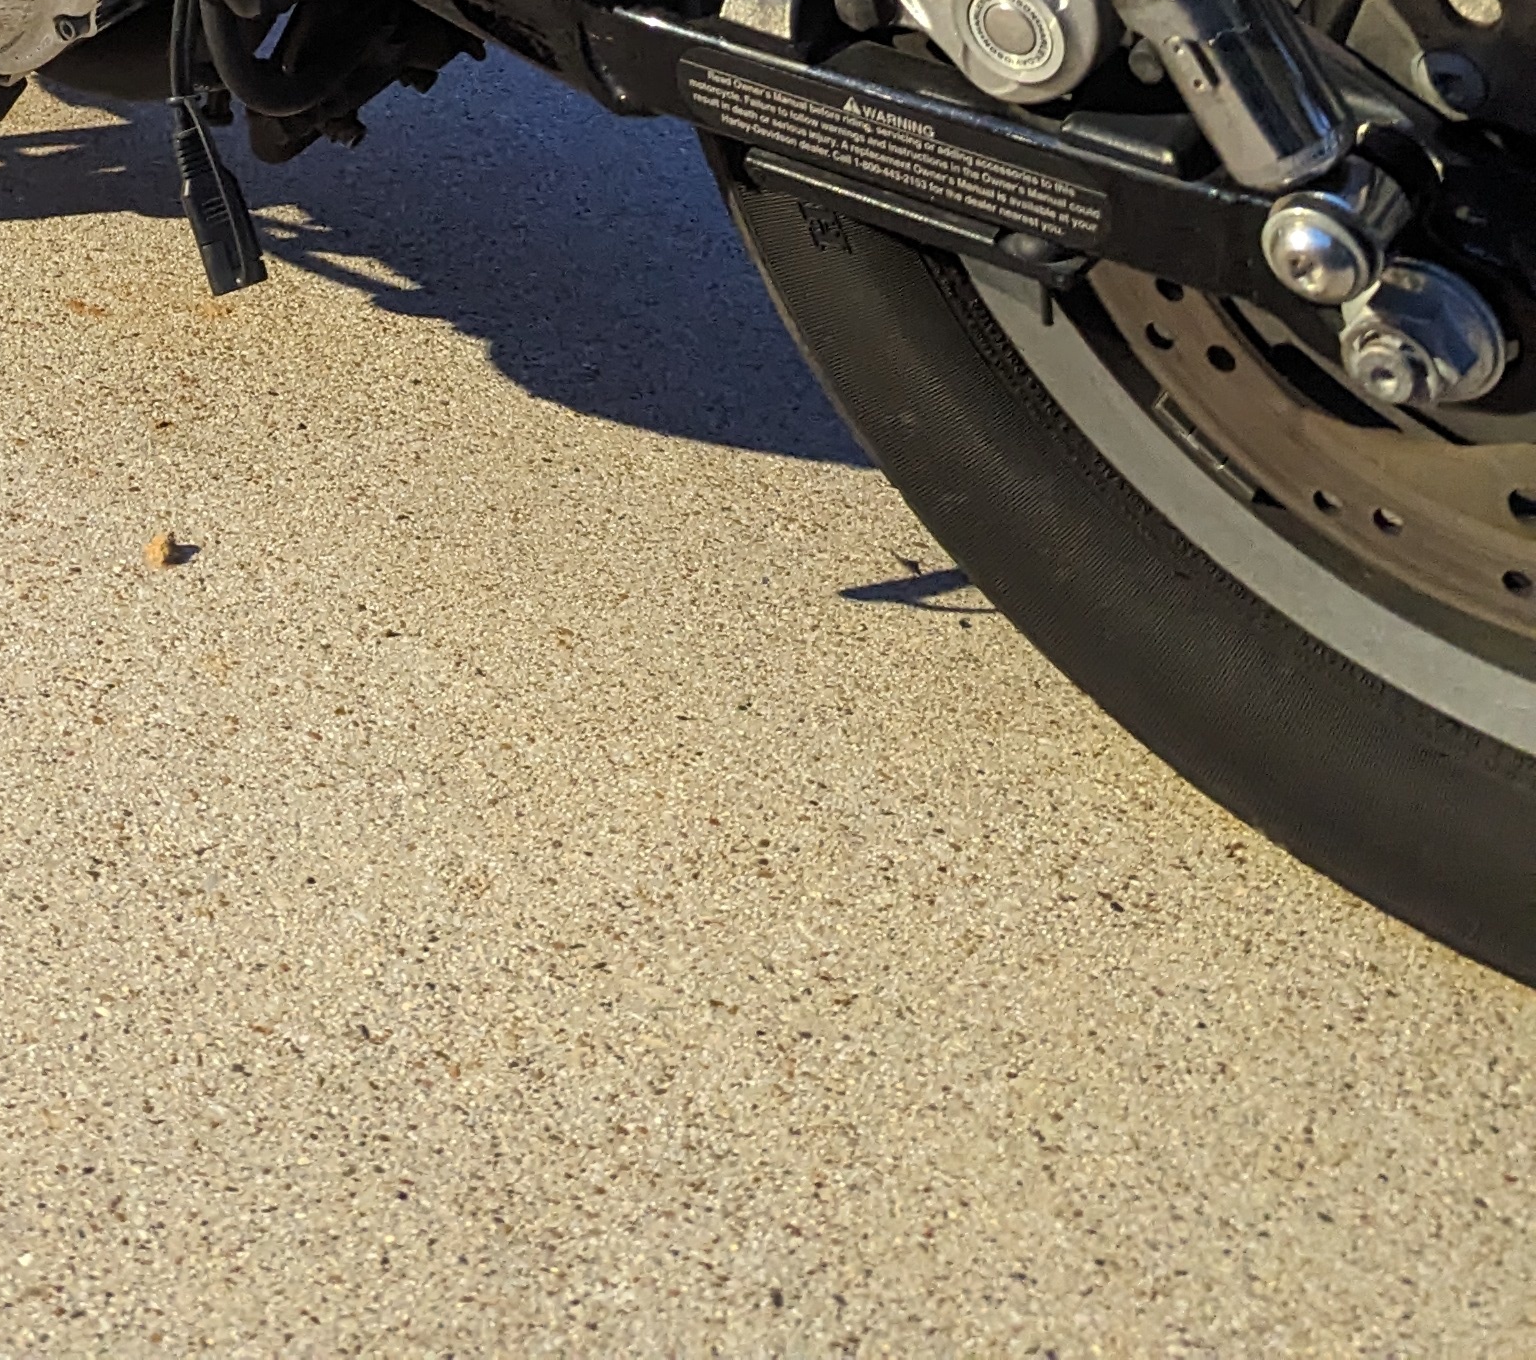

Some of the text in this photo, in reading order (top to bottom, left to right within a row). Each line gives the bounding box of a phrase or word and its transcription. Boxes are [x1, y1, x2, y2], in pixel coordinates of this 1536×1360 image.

[693, 92, 719, 108] result
[732, 104, 757, 121] death
[772, 117, 806, 137] serious
[850, 142, 910, 173] replacement
[913, 163, 955, 185] Owner's
[957, 177, 994, 198] Manual
[1010, 194, 1056, 218] available
[1071, 216, 1097, 234] your
[707, 69, 731, 86] Read
[733, 78, 770, 99] Owner's
[773, 90, 807, 111] Manual
[809, 102, 840, 121] before
[876, 123, 921, 150] servicing
[937, 143, 972, 166] adding
[975, 155, 1038, 185] accessories
[1054, 181, 1074, 197] this
[722, 113, 797, 150] Harley-Davidson
[832, 149, 851, 165] Call
[964, 192, 996, 212] dealer
[999, 203, 1038, 226] nearest
[744, 95, 775, 114] Failure
[790, 109, 817, 127] follow
[820, 119, 866, 145] warnings
[888, 141, 948, 170] instructions
[982, 171, 1025, 195] Owner's
[1027, 186, 1066, 208] Manual
[1068, 199, 1100, 219] could
[862, 104, 935, 140] WARNING
